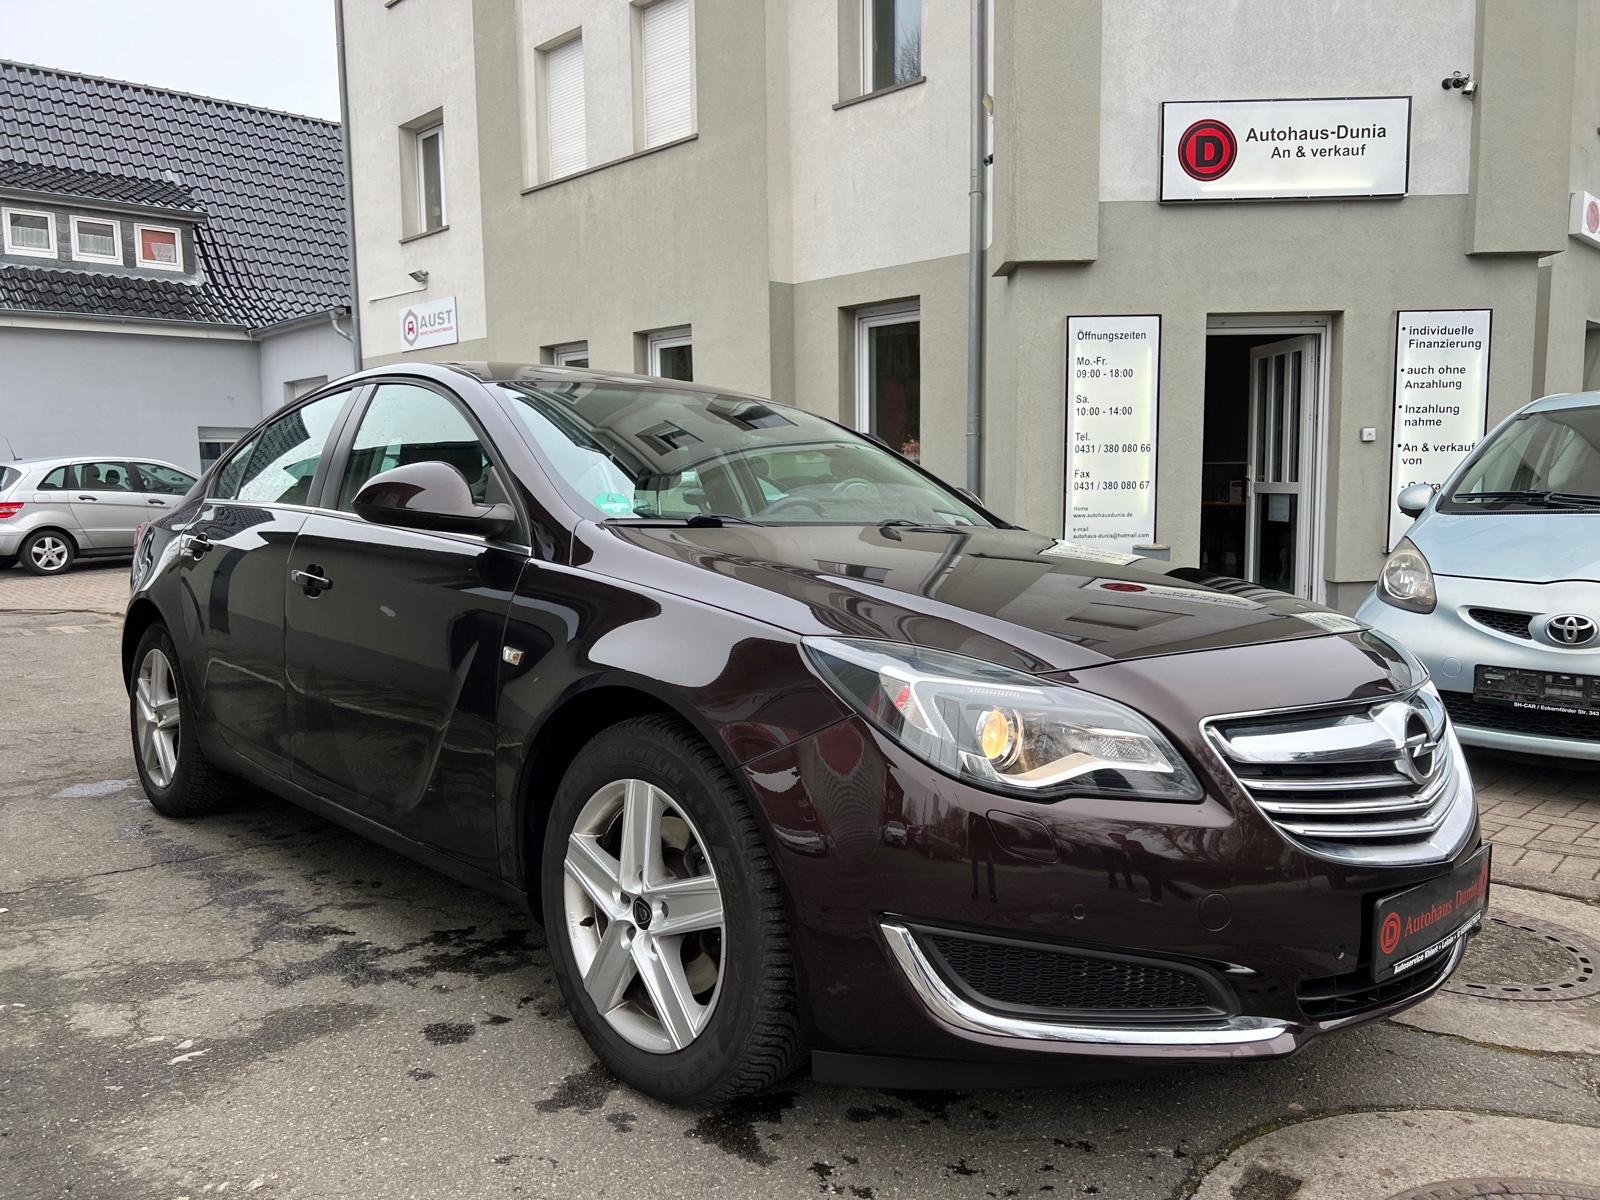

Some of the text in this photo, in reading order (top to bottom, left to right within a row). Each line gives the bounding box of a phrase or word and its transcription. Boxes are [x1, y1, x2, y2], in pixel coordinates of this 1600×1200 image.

[1245, 123, 1386, 143] Autohaus-Dunia
[1270, 144, 1366, 158] An & verkauf
[420, 310, 452, 329] AUST
[1077, 329, 1146, 342] Öffnungszeiten
[1409, 326, 1474, 336] individuelle
[1408, 339, 1482, 350] Finanzierung
[1076, 356, 1107, 366] Mo.-Fr.
[1076, 369, 1100, 378] 09:00
[1110, 369, 1133, 378] 18:00
[1407, 365, 1466, 374] auch ohne
[1404, 380, 1462, 390] Anzahlung
[1076, 395, 1090, 404] Sa.
[1076, 407, 1100, 416] 10:00
[1109, 406, 1132, 415] 14:00
[1405, 404, 1460, 415] Inzahlung
[1404, 418, 1442, 426] nahme
[1075, 432, 1090, 441] Tel.
[1075, 444, 1151, 453] 0431 / 380 080 66
[1403, 443, 1476, 452] An & verkauf
[1075, 470, 1090, 478] Fax
[1074, 481, 1150, 490] 0431 / 380 080 67
[1540, 705, 1577, 714] Eckernförder
[1405, 900, 1453, 936] Autohaus
